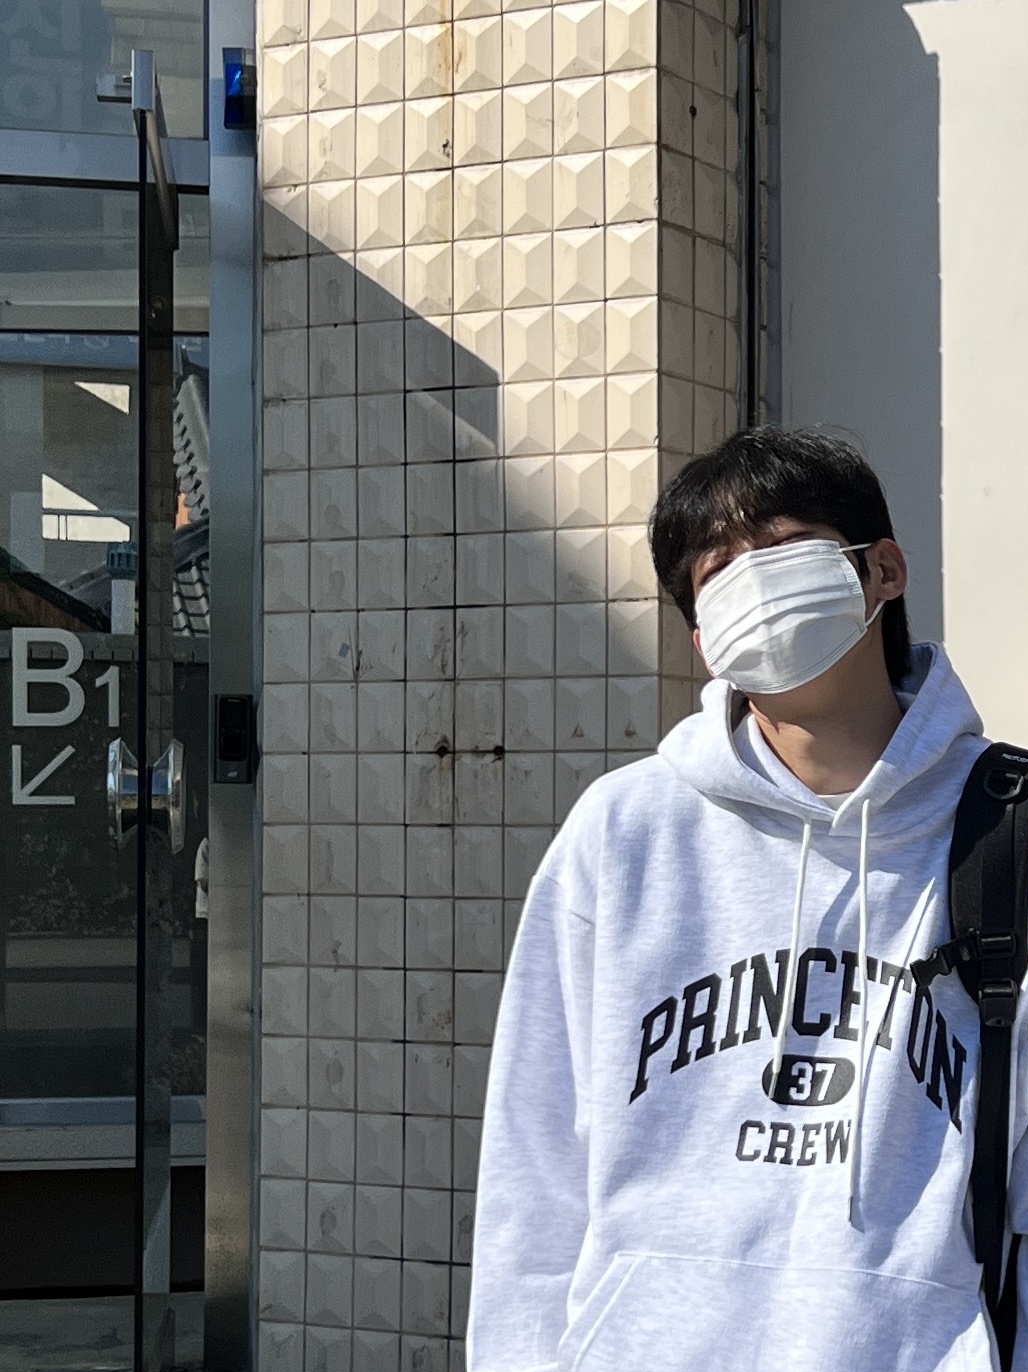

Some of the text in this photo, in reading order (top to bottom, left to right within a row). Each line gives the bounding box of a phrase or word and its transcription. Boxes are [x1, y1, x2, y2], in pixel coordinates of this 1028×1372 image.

[12, 627, 120, 727] B1
[628, 947, 967, 1134] PRINCETON
[788, 1061, 837, 1102] 37
[735, 1119, 852, 1166] CREW
